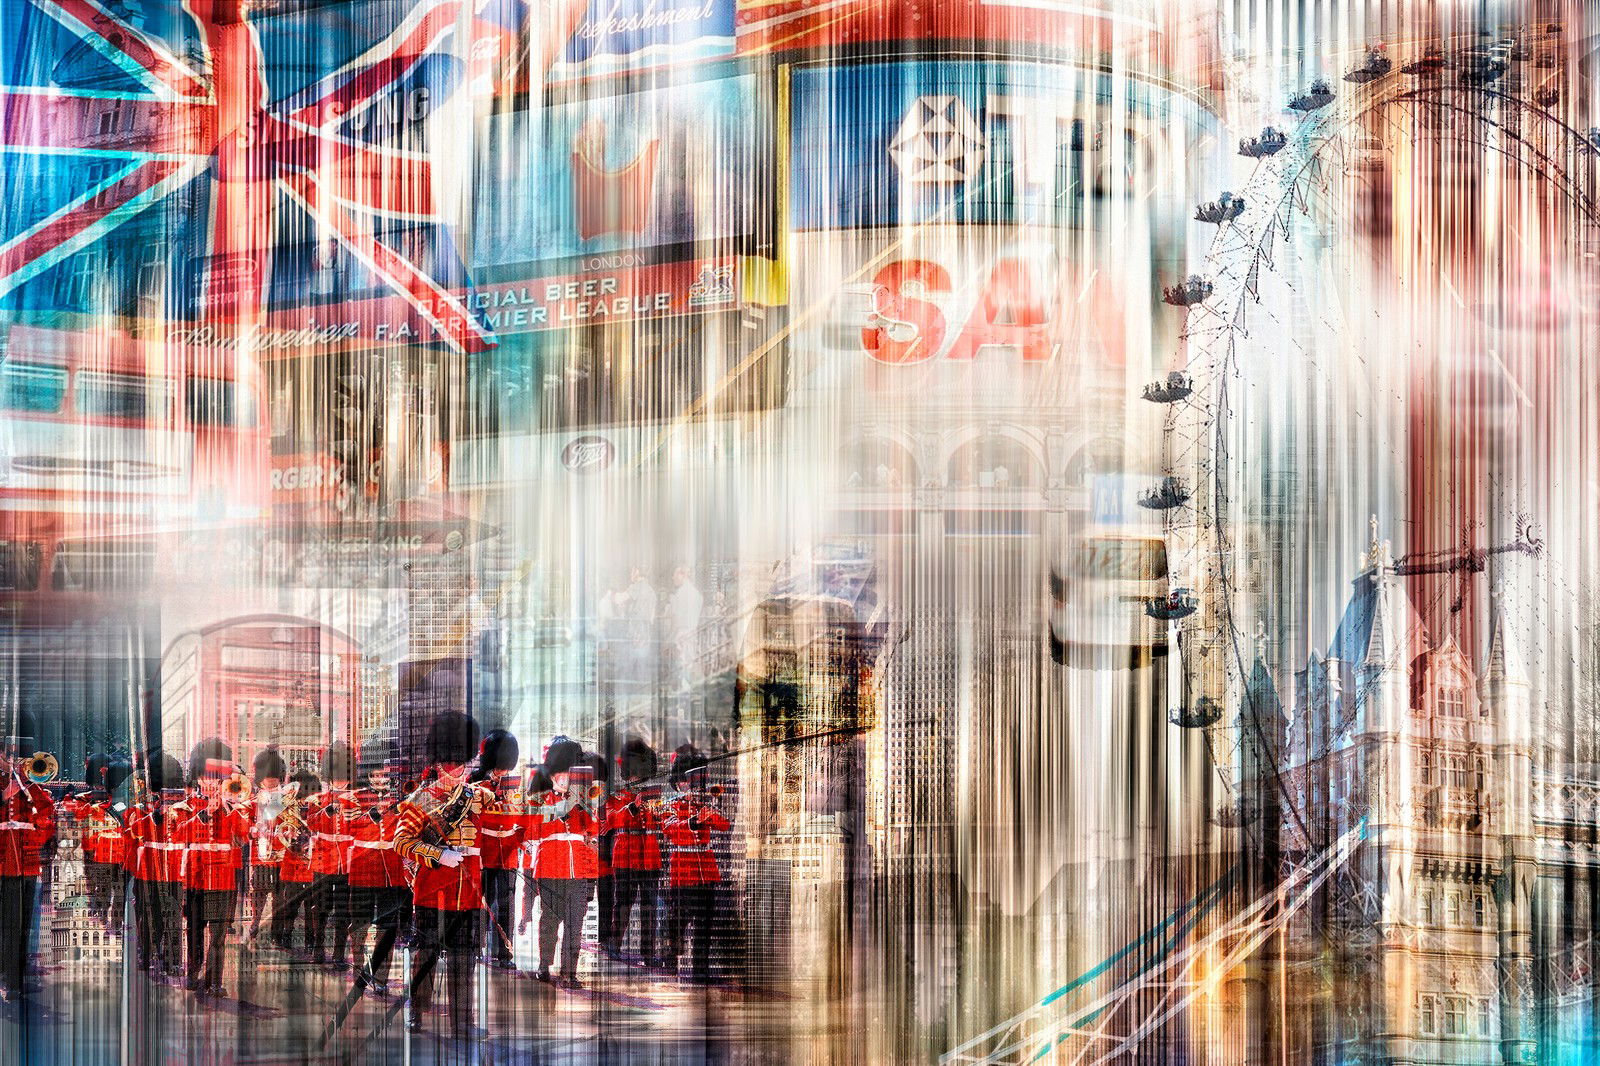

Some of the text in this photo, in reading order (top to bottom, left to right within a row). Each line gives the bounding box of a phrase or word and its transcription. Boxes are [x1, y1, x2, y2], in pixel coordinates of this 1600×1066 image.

[581, 253, 646, 272] LONDON
[375, 321, 418, 341] F.A.
[559, 292, 672, 322] LEAGUE
[416, 277, 617, 319] OFFICIAL BEER
